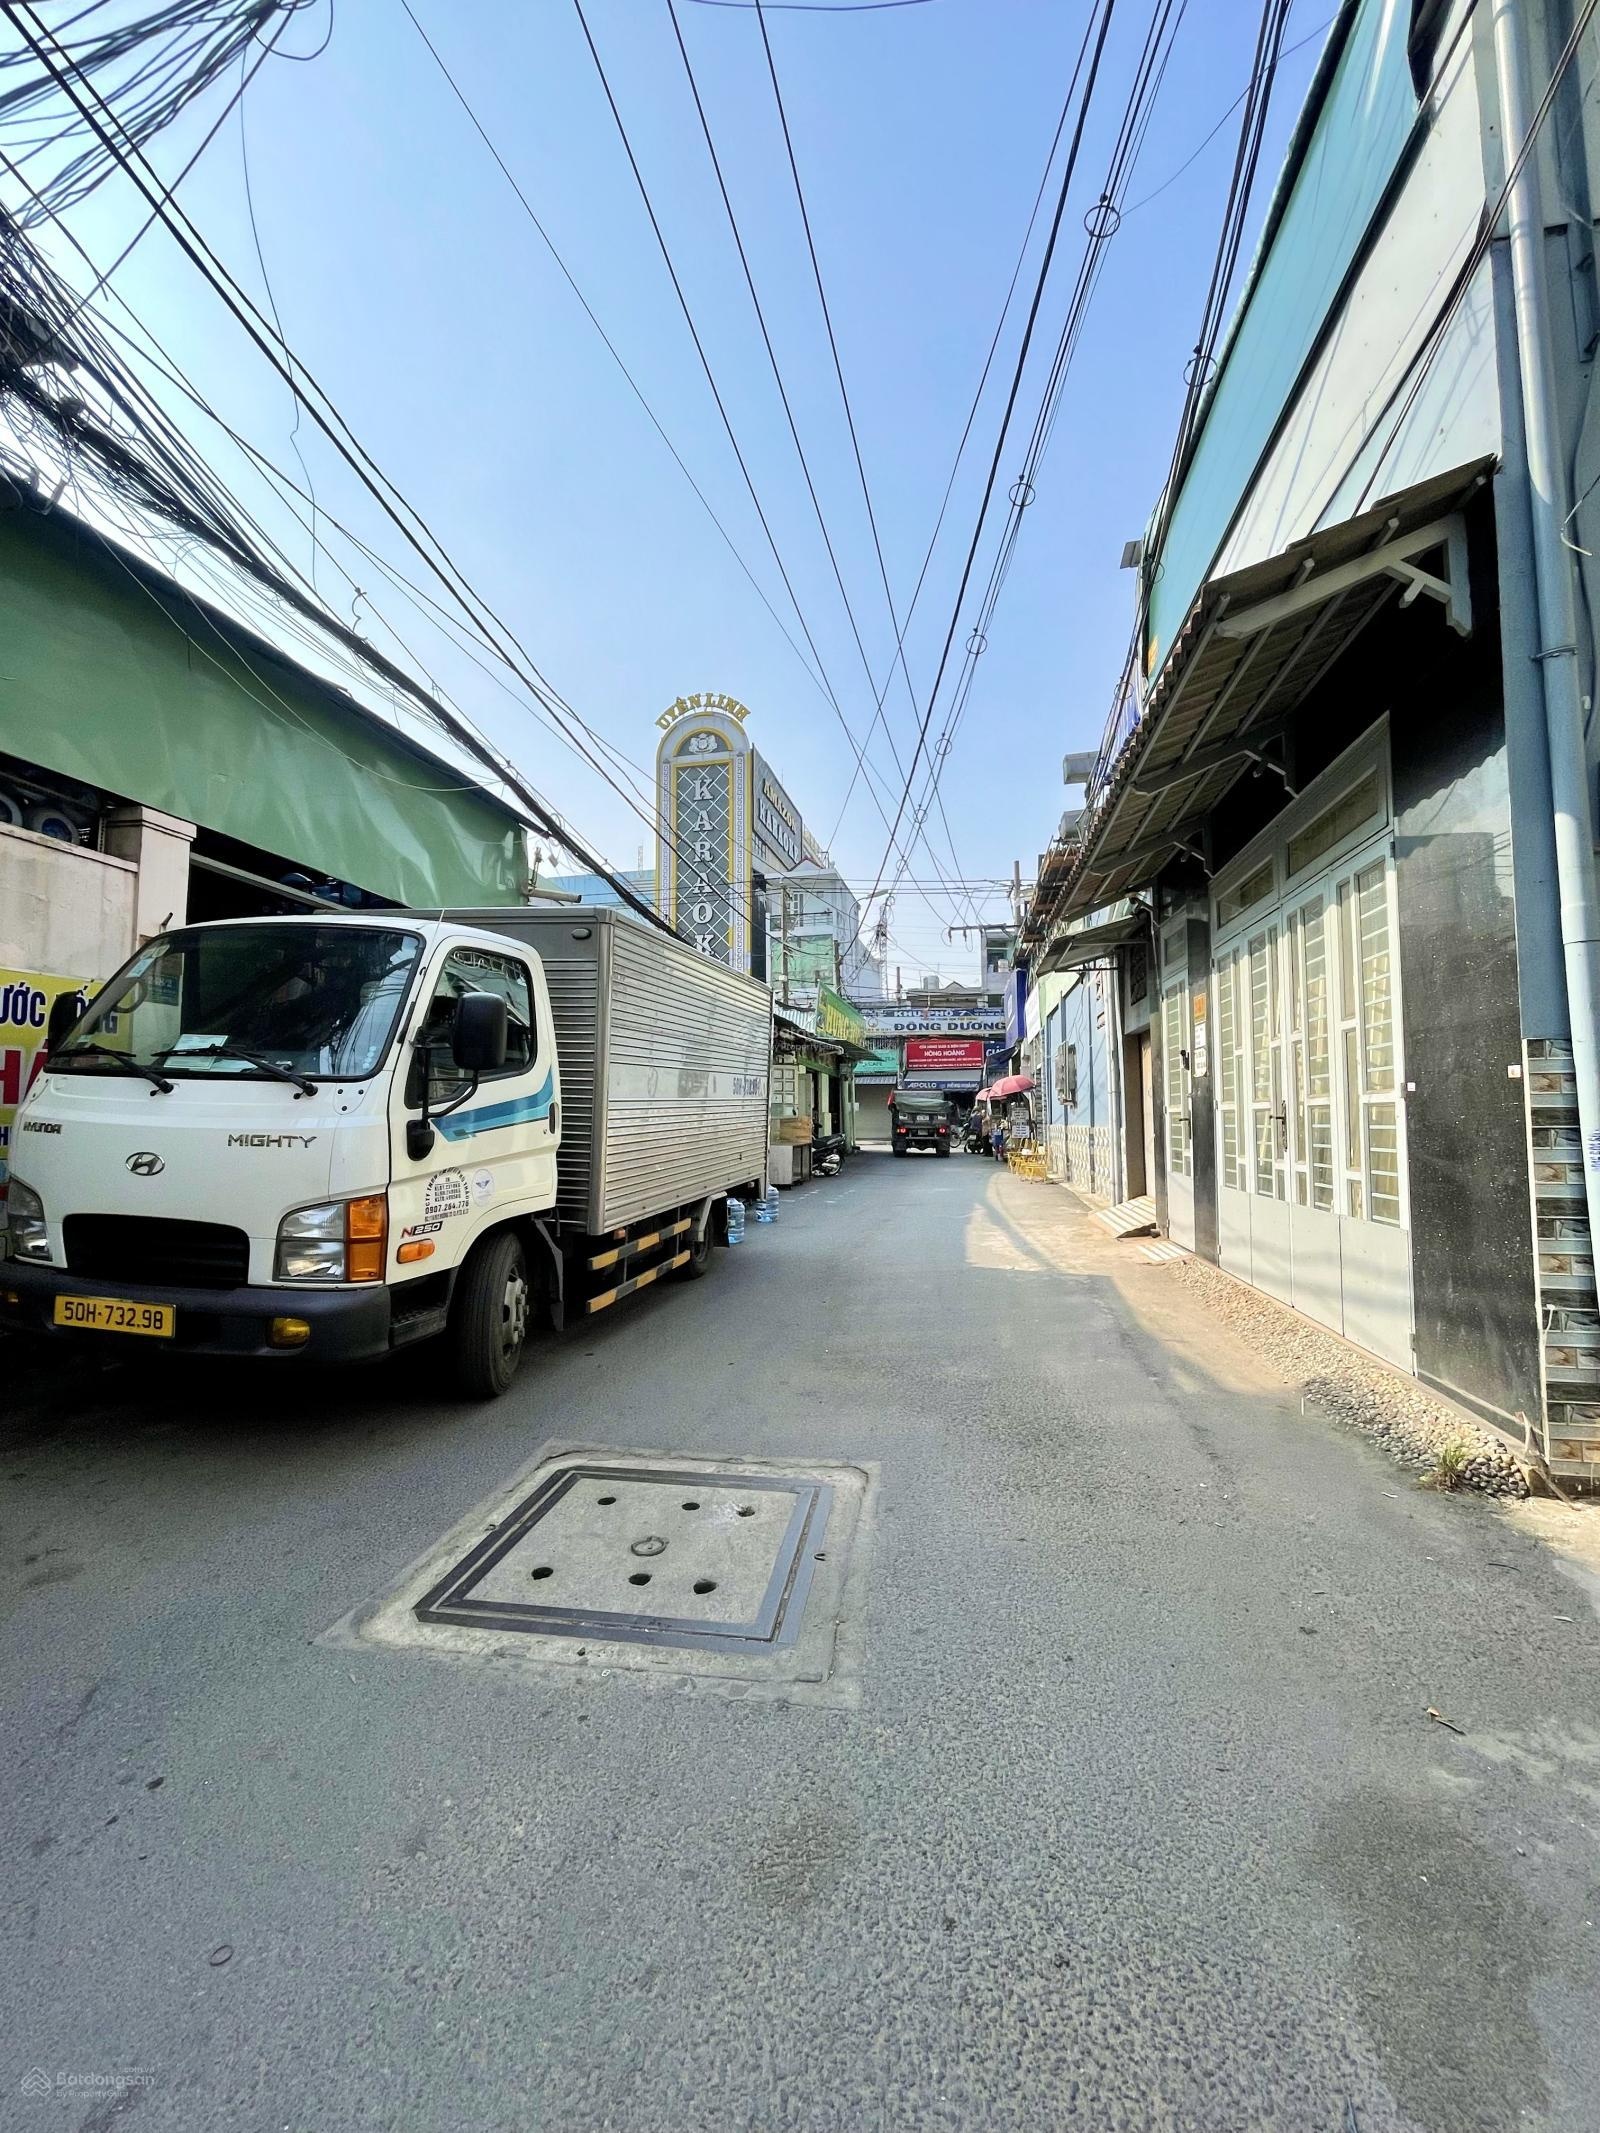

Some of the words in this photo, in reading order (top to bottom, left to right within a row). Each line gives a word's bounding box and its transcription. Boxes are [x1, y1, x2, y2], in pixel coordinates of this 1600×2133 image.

[655, 693, 702, 730] UYÊN
[704, 692, 751, 724] LINH
[762, 778, 797, 835] AMAZON
[758, 798, 799, 865] KARAOKE
[693, 777, 714, 957] KARAOK
[23, 1121, 62, 1134] HYUNDAI
[228, 1134, 317, 1148] MIGHTY
[64, 1302, 163, 1330] 50H-732.98
